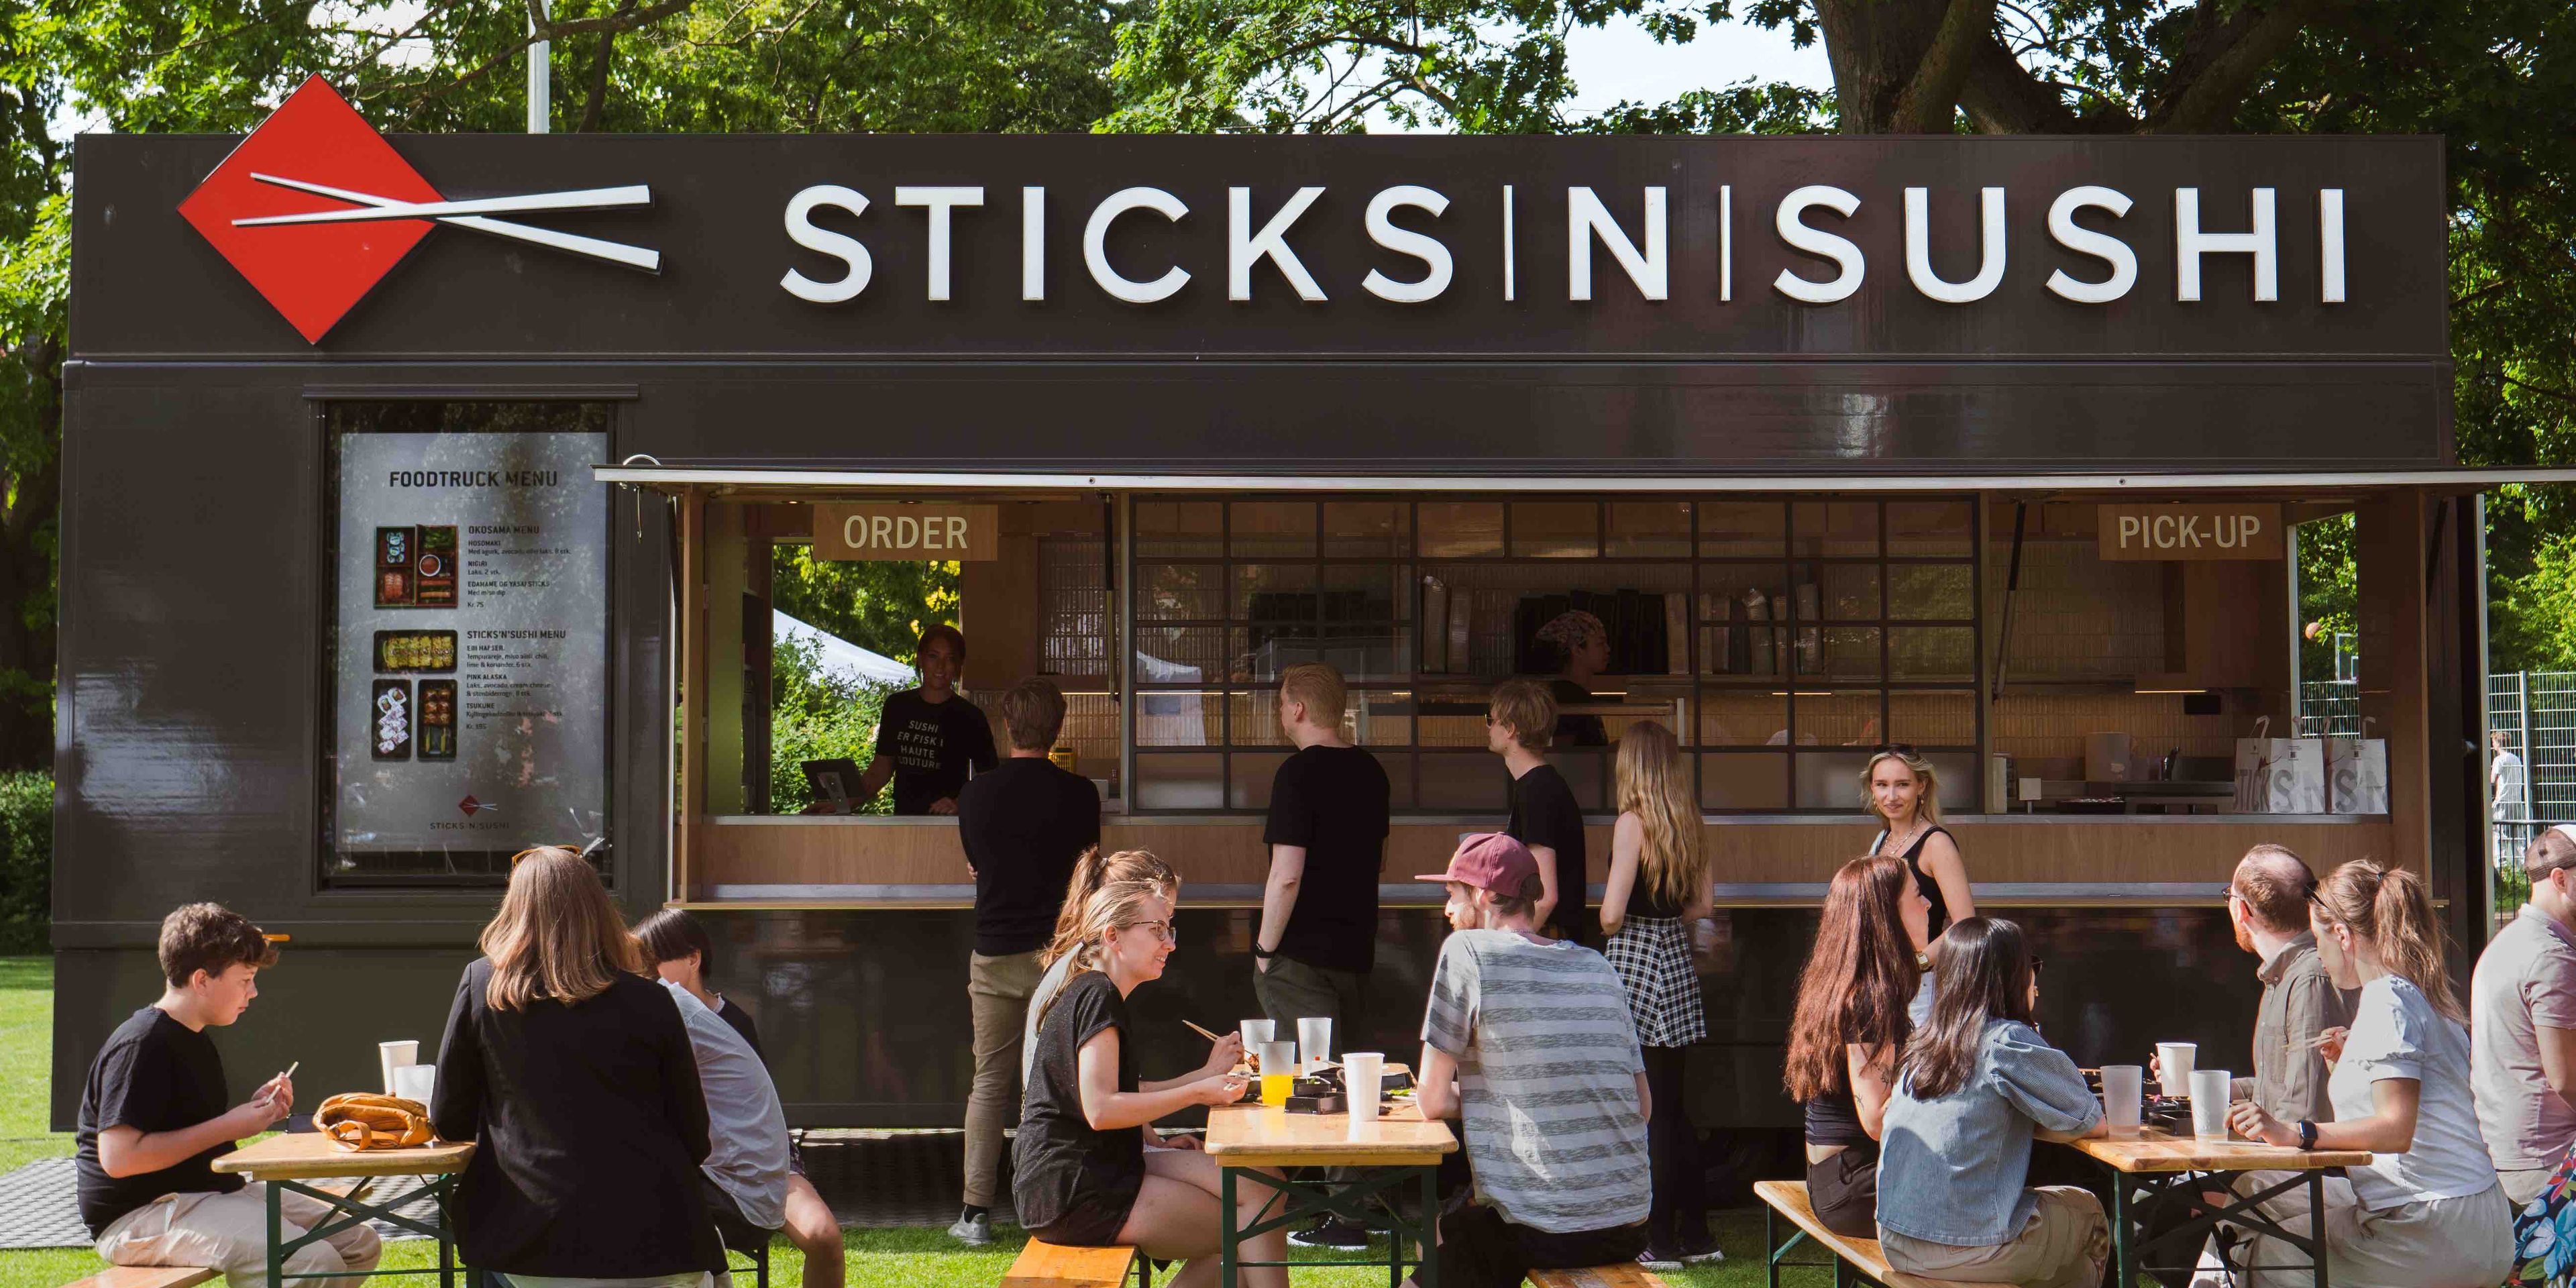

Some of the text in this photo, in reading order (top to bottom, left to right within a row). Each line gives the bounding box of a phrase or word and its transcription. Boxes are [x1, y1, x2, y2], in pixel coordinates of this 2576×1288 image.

[780, 184, 1453, 303] STICKS
[1772, 184, 2346, 303] SUSHI
[389, 471, 557, 487] FOODTRUCK MENU
[468, 526, 539, 534] OKOSAMA MENU
[844, 515, 968, 549] ORDER
[2119, 515, 2261, 549] PICK-UP
[540, 631, 566, 639] MENU
[908, 720, 938, 733] SUSHI
[897, 731, 910, 741] ER
[913, 734, 936, 746] FISK
[901, 745, 934, 759] HAUTE
[429, 822, 464, 830] STICKS
[479, 822, 510, 830] SUSHI
